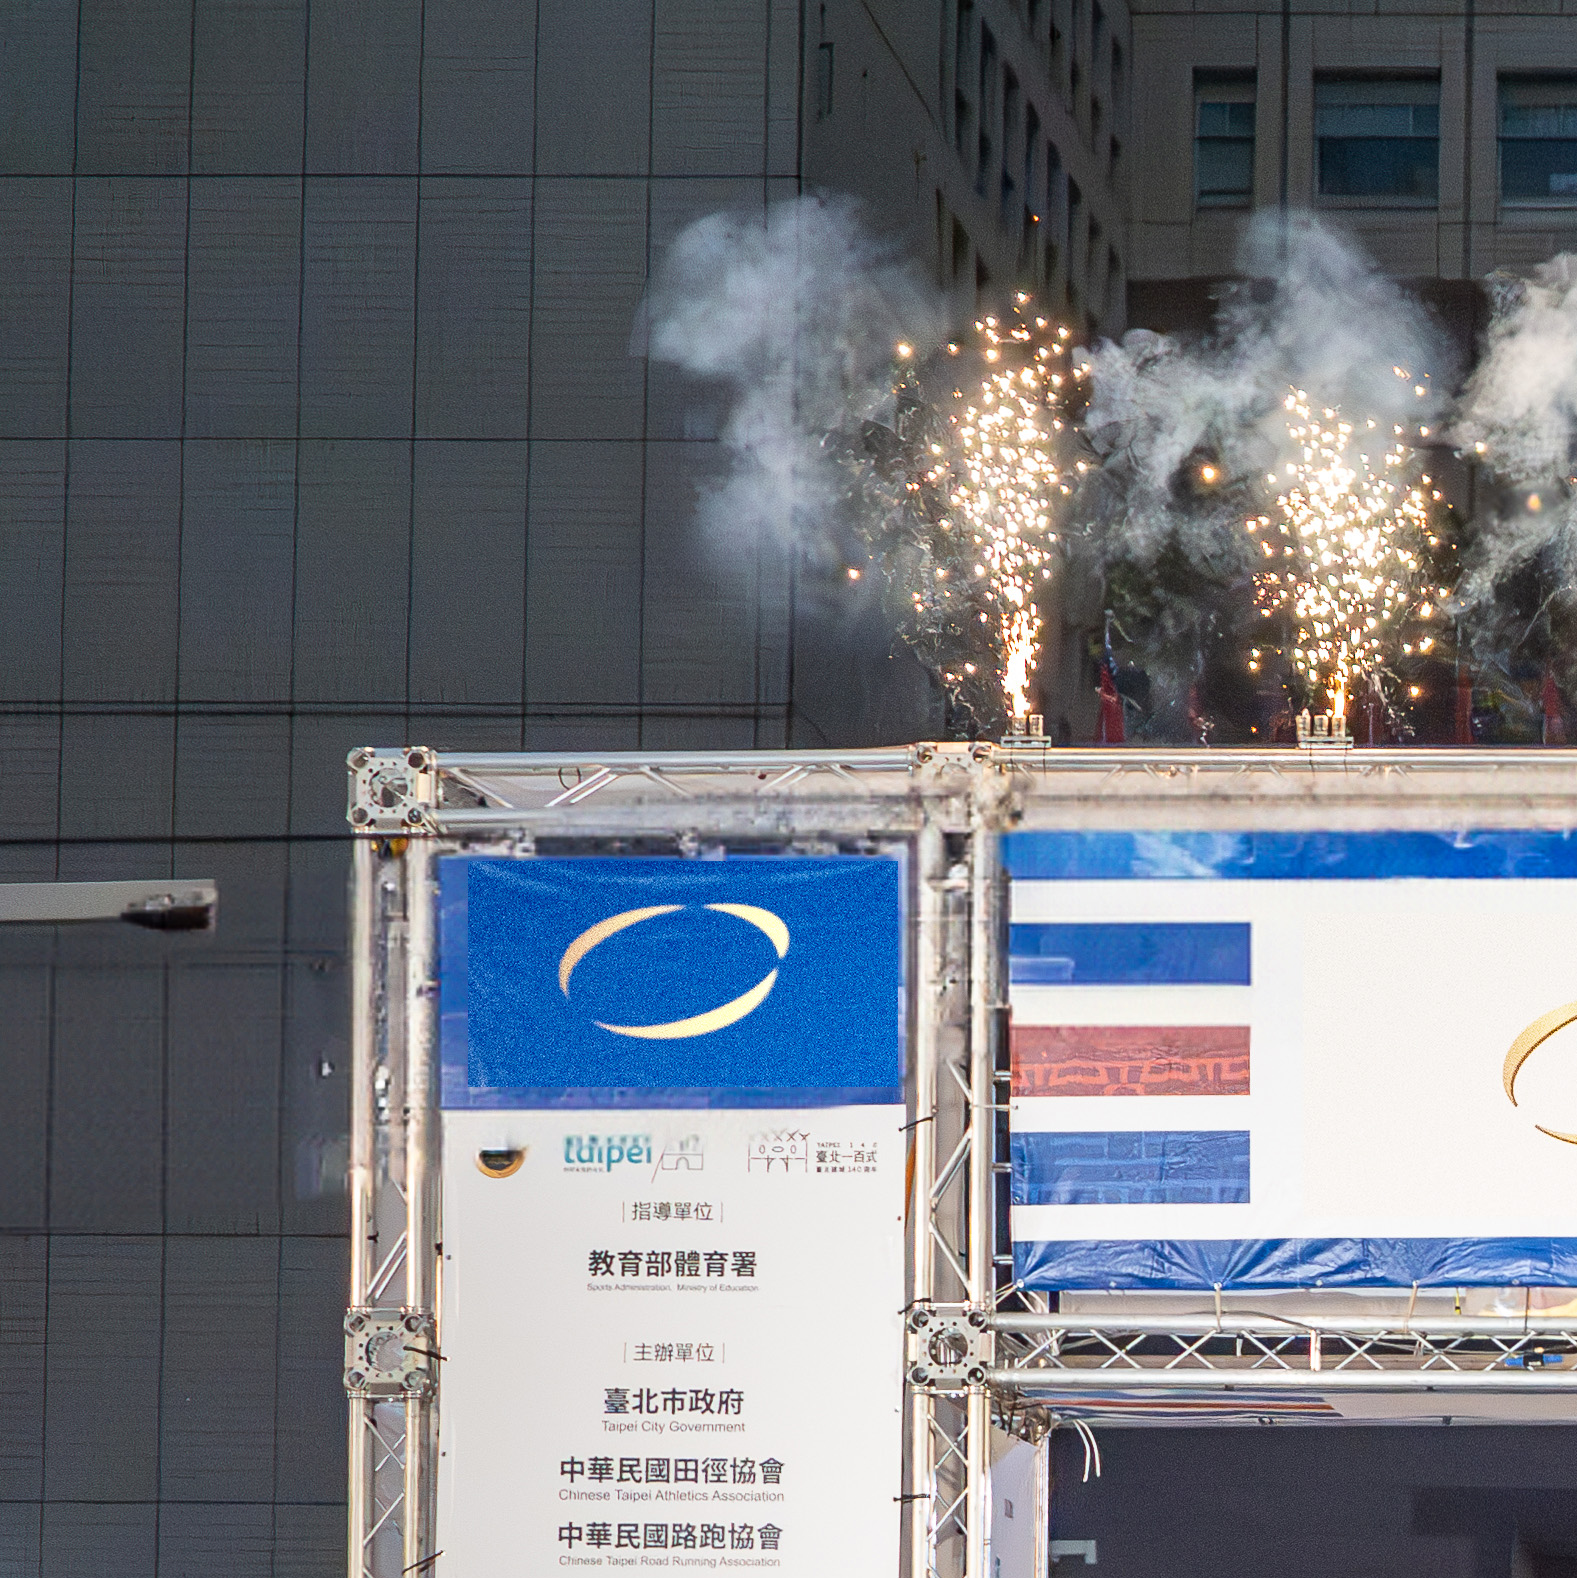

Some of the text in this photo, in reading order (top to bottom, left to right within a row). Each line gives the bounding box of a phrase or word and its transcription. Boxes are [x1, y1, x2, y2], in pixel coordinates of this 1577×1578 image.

[631, 1201, 715, 1222] 指導單位
[588, 1250, 758, 1279] 教育部體育署
[586, 1283, 613, 1294] Sports
[632, 1342, 716, 1363] 主辦單位
[604, 1387, 745, 1416] 臺北市政府
[601, 1420, 746, 1435] Taipei City Government
[560, 1456, 785, 1485] 中華民國田徑協會
[558, 1488, 785, 1503] Chinese Taipei Athletics Association
[557, 1522, 783, 1551] 中華民國路跑協會
[558, 1555, 781, 1569] Chinese Taipei Road Running Association
